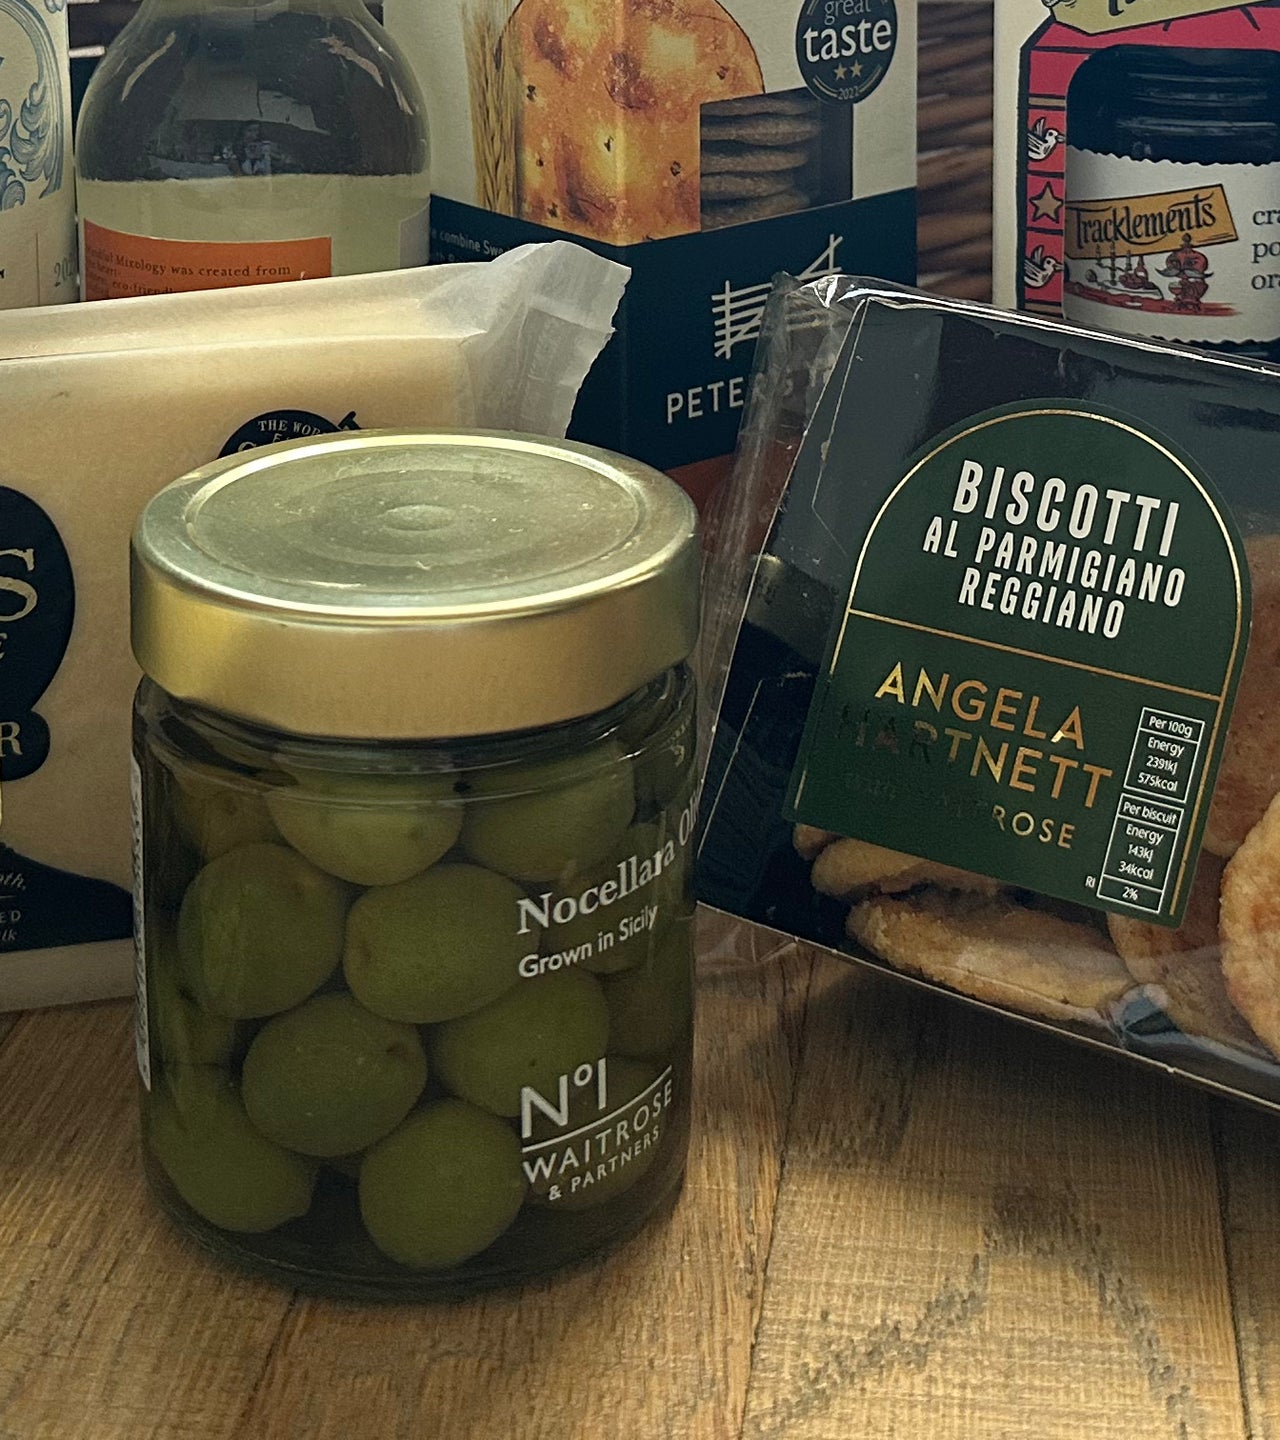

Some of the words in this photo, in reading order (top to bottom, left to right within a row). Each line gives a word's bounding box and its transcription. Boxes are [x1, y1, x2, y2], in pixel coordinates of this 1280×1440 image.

[802, 18, 892, 63] taste
[1066, 191, 1216, 249] Tracklements
[115, 253, 167, 276] Mixology
[170, 266, 195, 276] was
[198, 265, 250, 278] created
[255, 265, 292, 277] from
[257, 418, 289, 433] THE
[952, 459, 1180, 558] BISCOTTI
[922, 516, 959, 560] AL
[974, 526, 1186, 608] PARMIGIANO
[958, 567, 1126, 640] REGGIANO
[874, 661, 1085, 750] ANGELA
[1148, 715, 1167, 731] Per
[1168, 721, 1194, 738] 100g
[1147, 736, 1185, 758] Energy
[1137, 771, 1179, 792] 575kcal
[1122, 801, 1141, 816] Per
[1142, 806, 1178, 826] biscuit
[1126, 823, 1164, 846] Energy
[517, 838, 676, 935] Nocellara
[1118, 860, 1154, 881] 34kcal
[1122, 886, 1139, 901] 2%
[517, 940, 594, 979] Grown
[597, 929, 614, 954] in
[617, 902, 660, 944] Sicily
[521, 1078, 673, 1186] WAITROSE
[548, 1184, 563, 1201] &
[570, 1127, 660, 1194] PARTNERS
